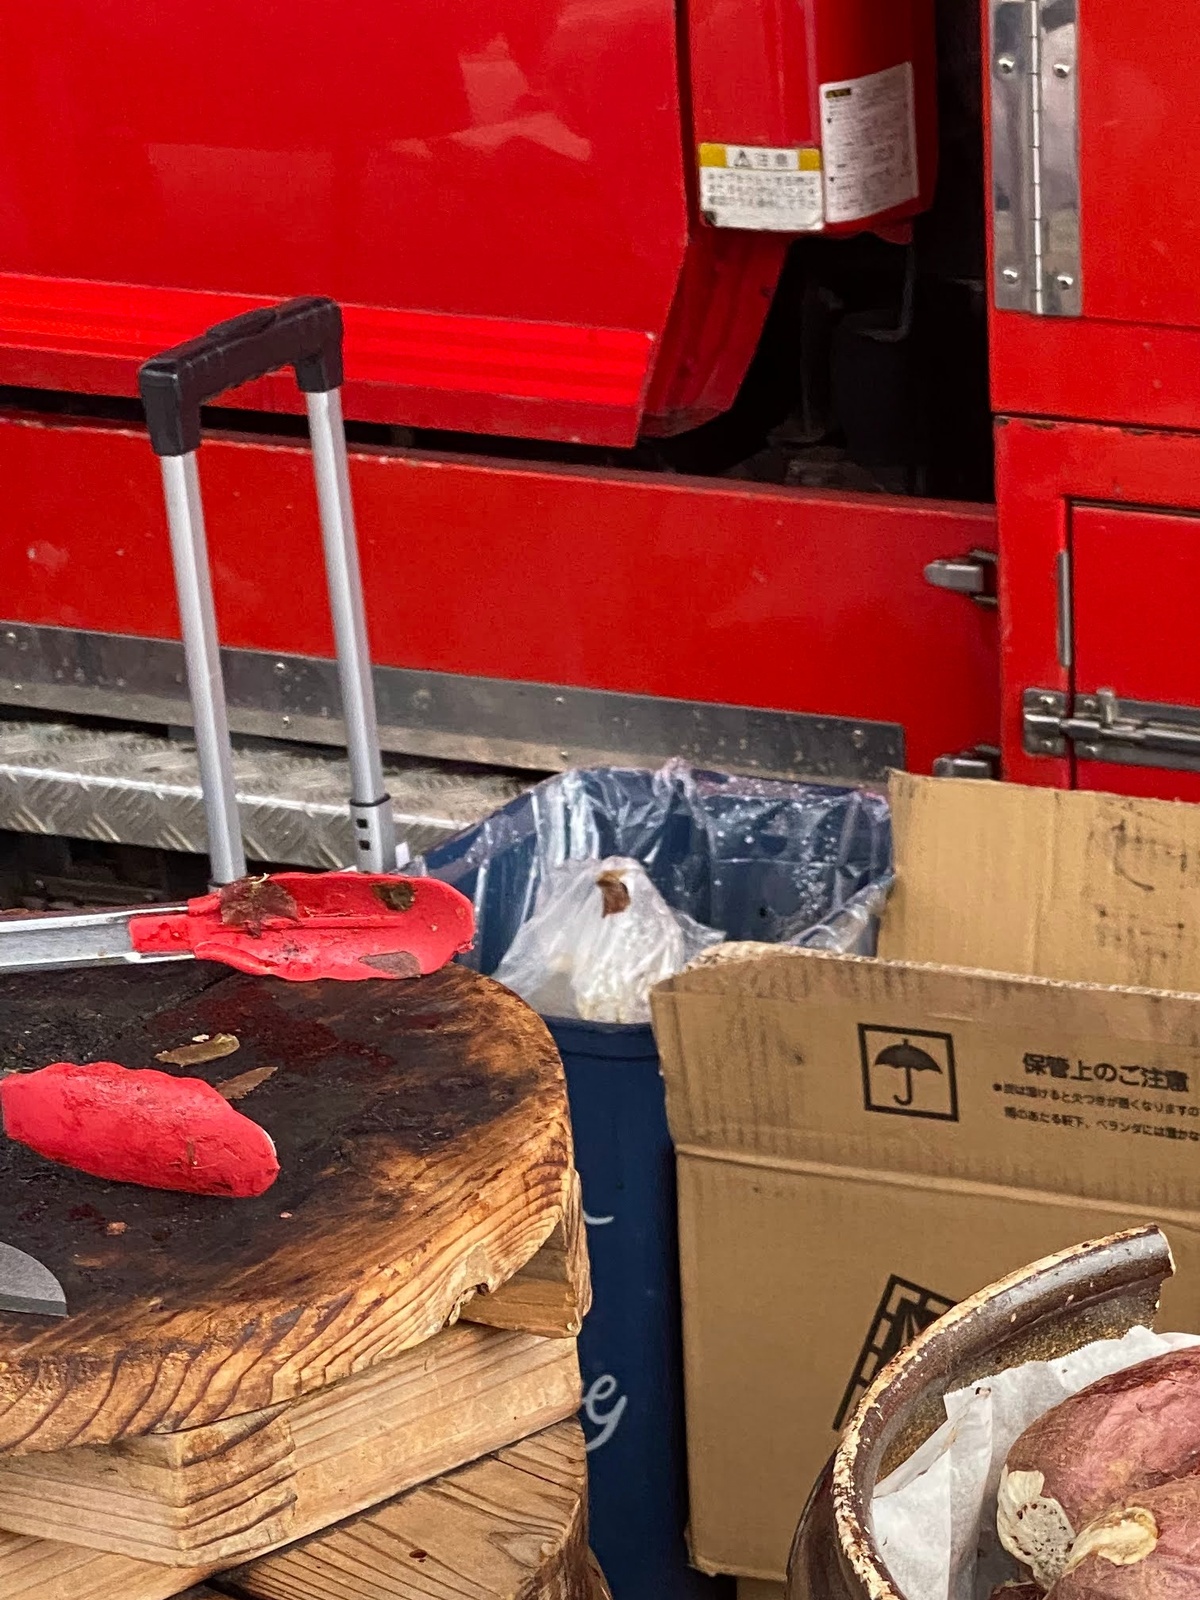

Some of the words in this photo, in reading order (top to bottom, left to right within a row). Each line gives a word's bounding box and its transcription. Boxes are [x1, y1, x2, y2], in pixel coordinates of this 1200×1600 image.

[1023, 1052, 1190, 1092] 保管上のご注意
